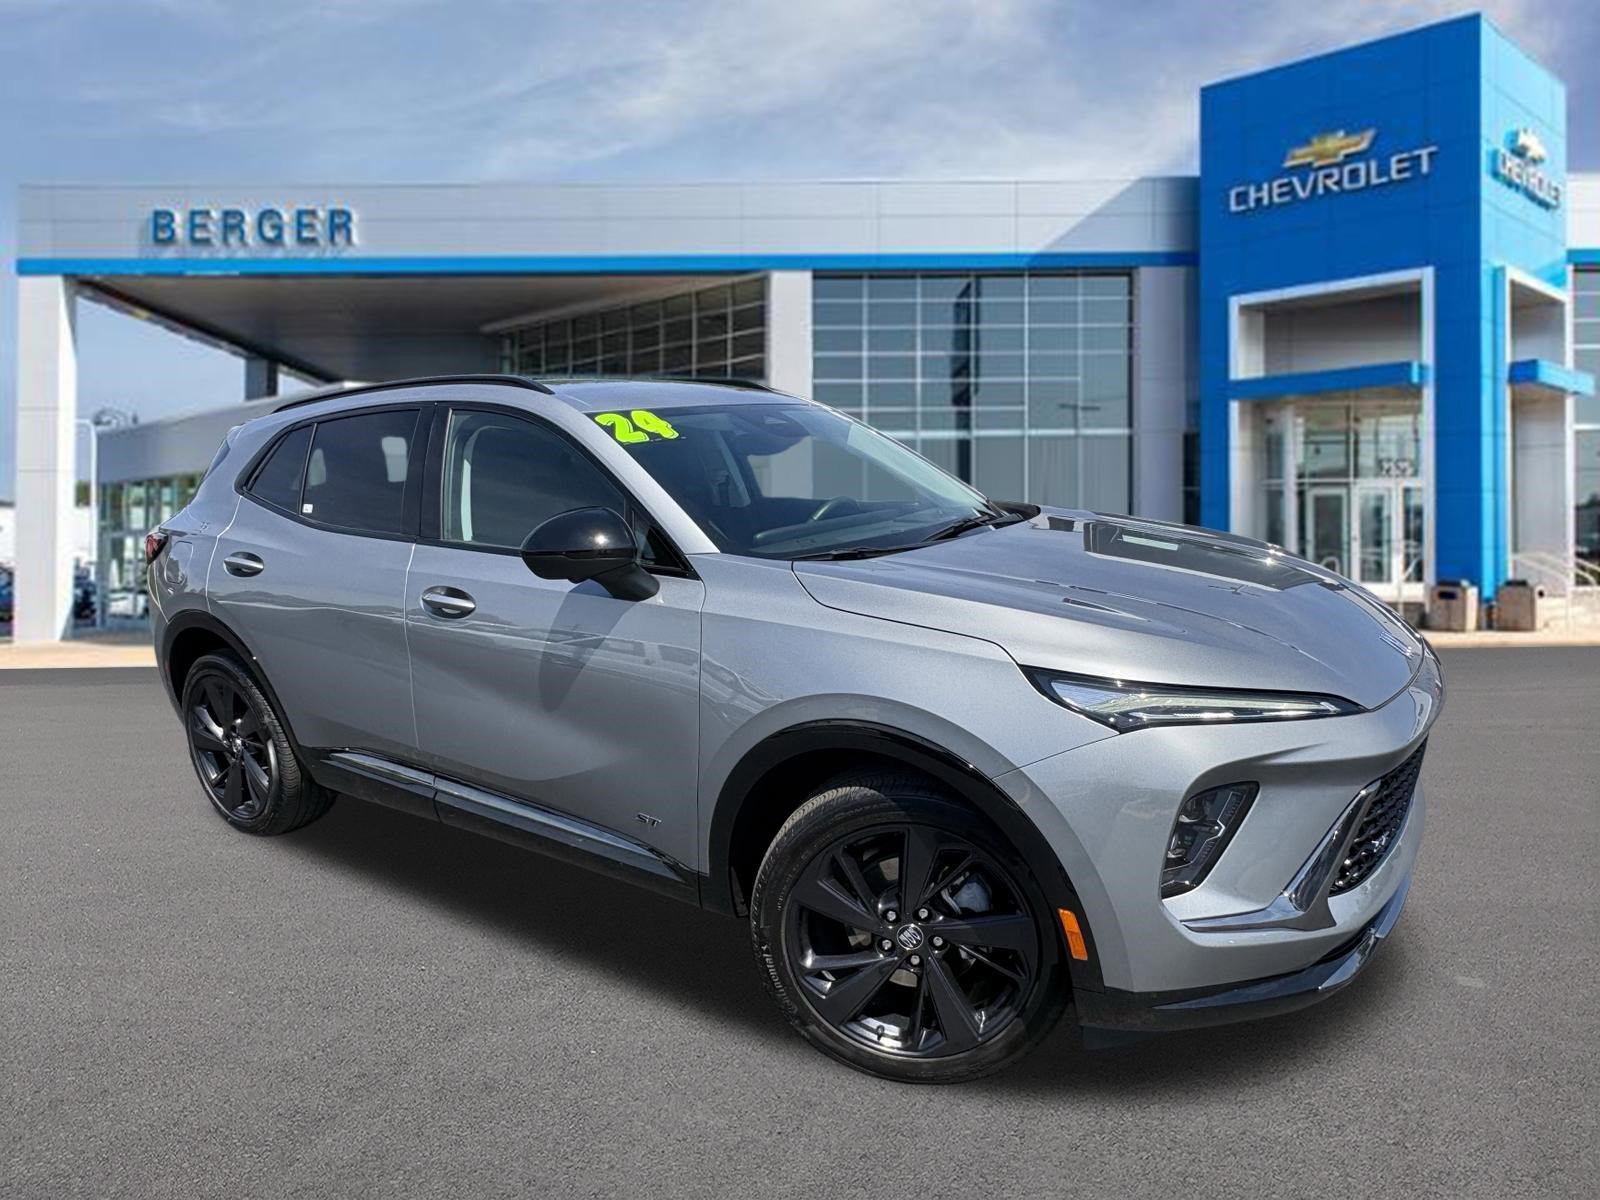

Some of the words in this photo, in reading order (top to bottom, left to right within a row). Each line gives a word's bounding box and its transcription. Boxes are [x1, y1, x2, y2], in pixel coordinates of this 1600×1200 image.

[1229, 146, 1438, 213] CHEVROLET
[152, 208, 354, 246] BERGER
[594, 409, 679, 443] 24
[636, 812, 662, 827] ST
